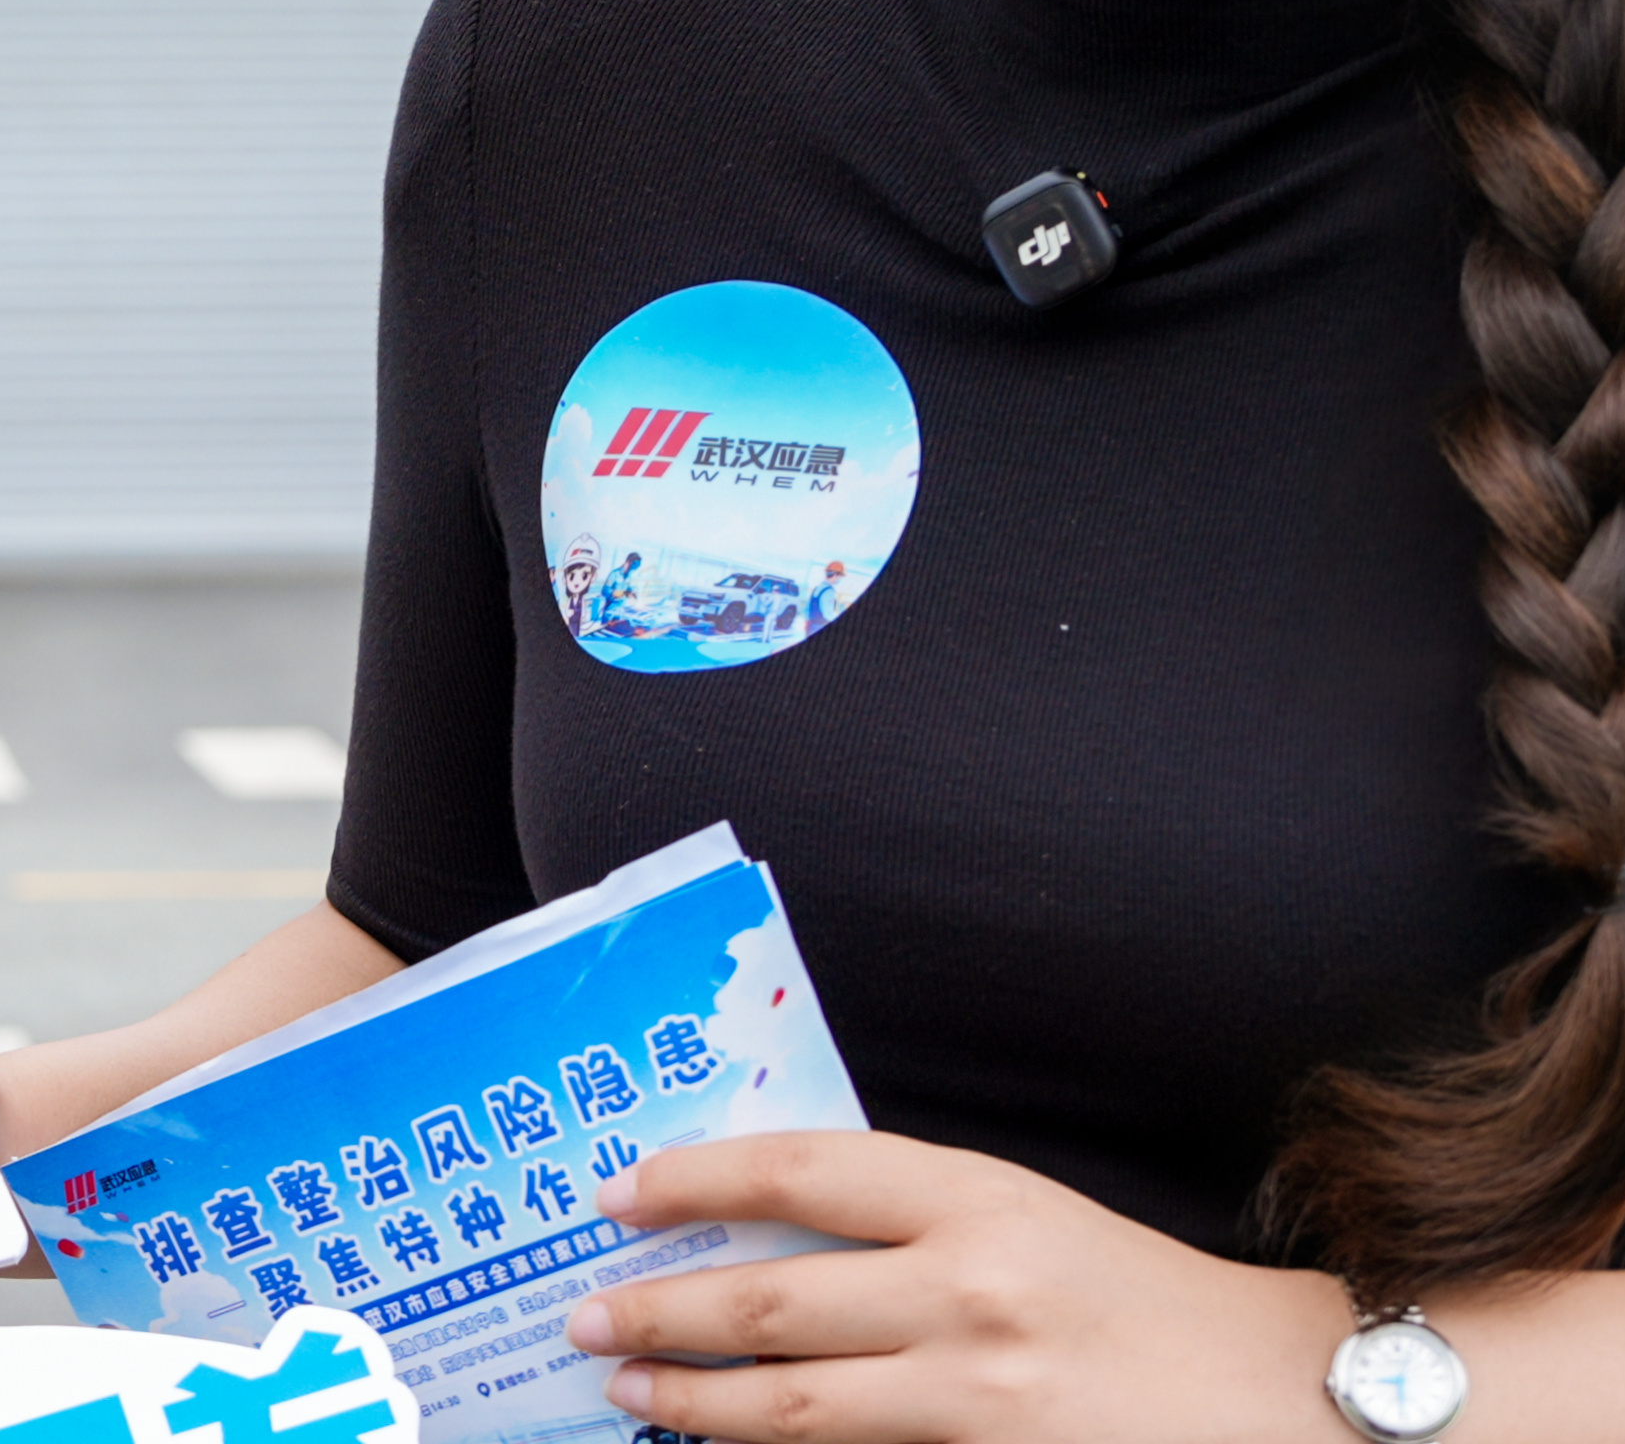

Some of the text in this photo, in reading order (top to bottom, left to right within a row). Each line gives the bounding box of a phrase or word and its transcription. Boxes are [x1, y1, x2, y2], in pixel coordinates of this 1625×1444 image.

[693, 437, 846, 476] 武汉应急
[690, 470, 836, 493] WHEM
[136, 1019, 719, 1284] 排查整治风险隐患
[99, 1159, 158, 1193] 武汉应急
[250, 1134, 639, 1322] 聚焦特种作业
